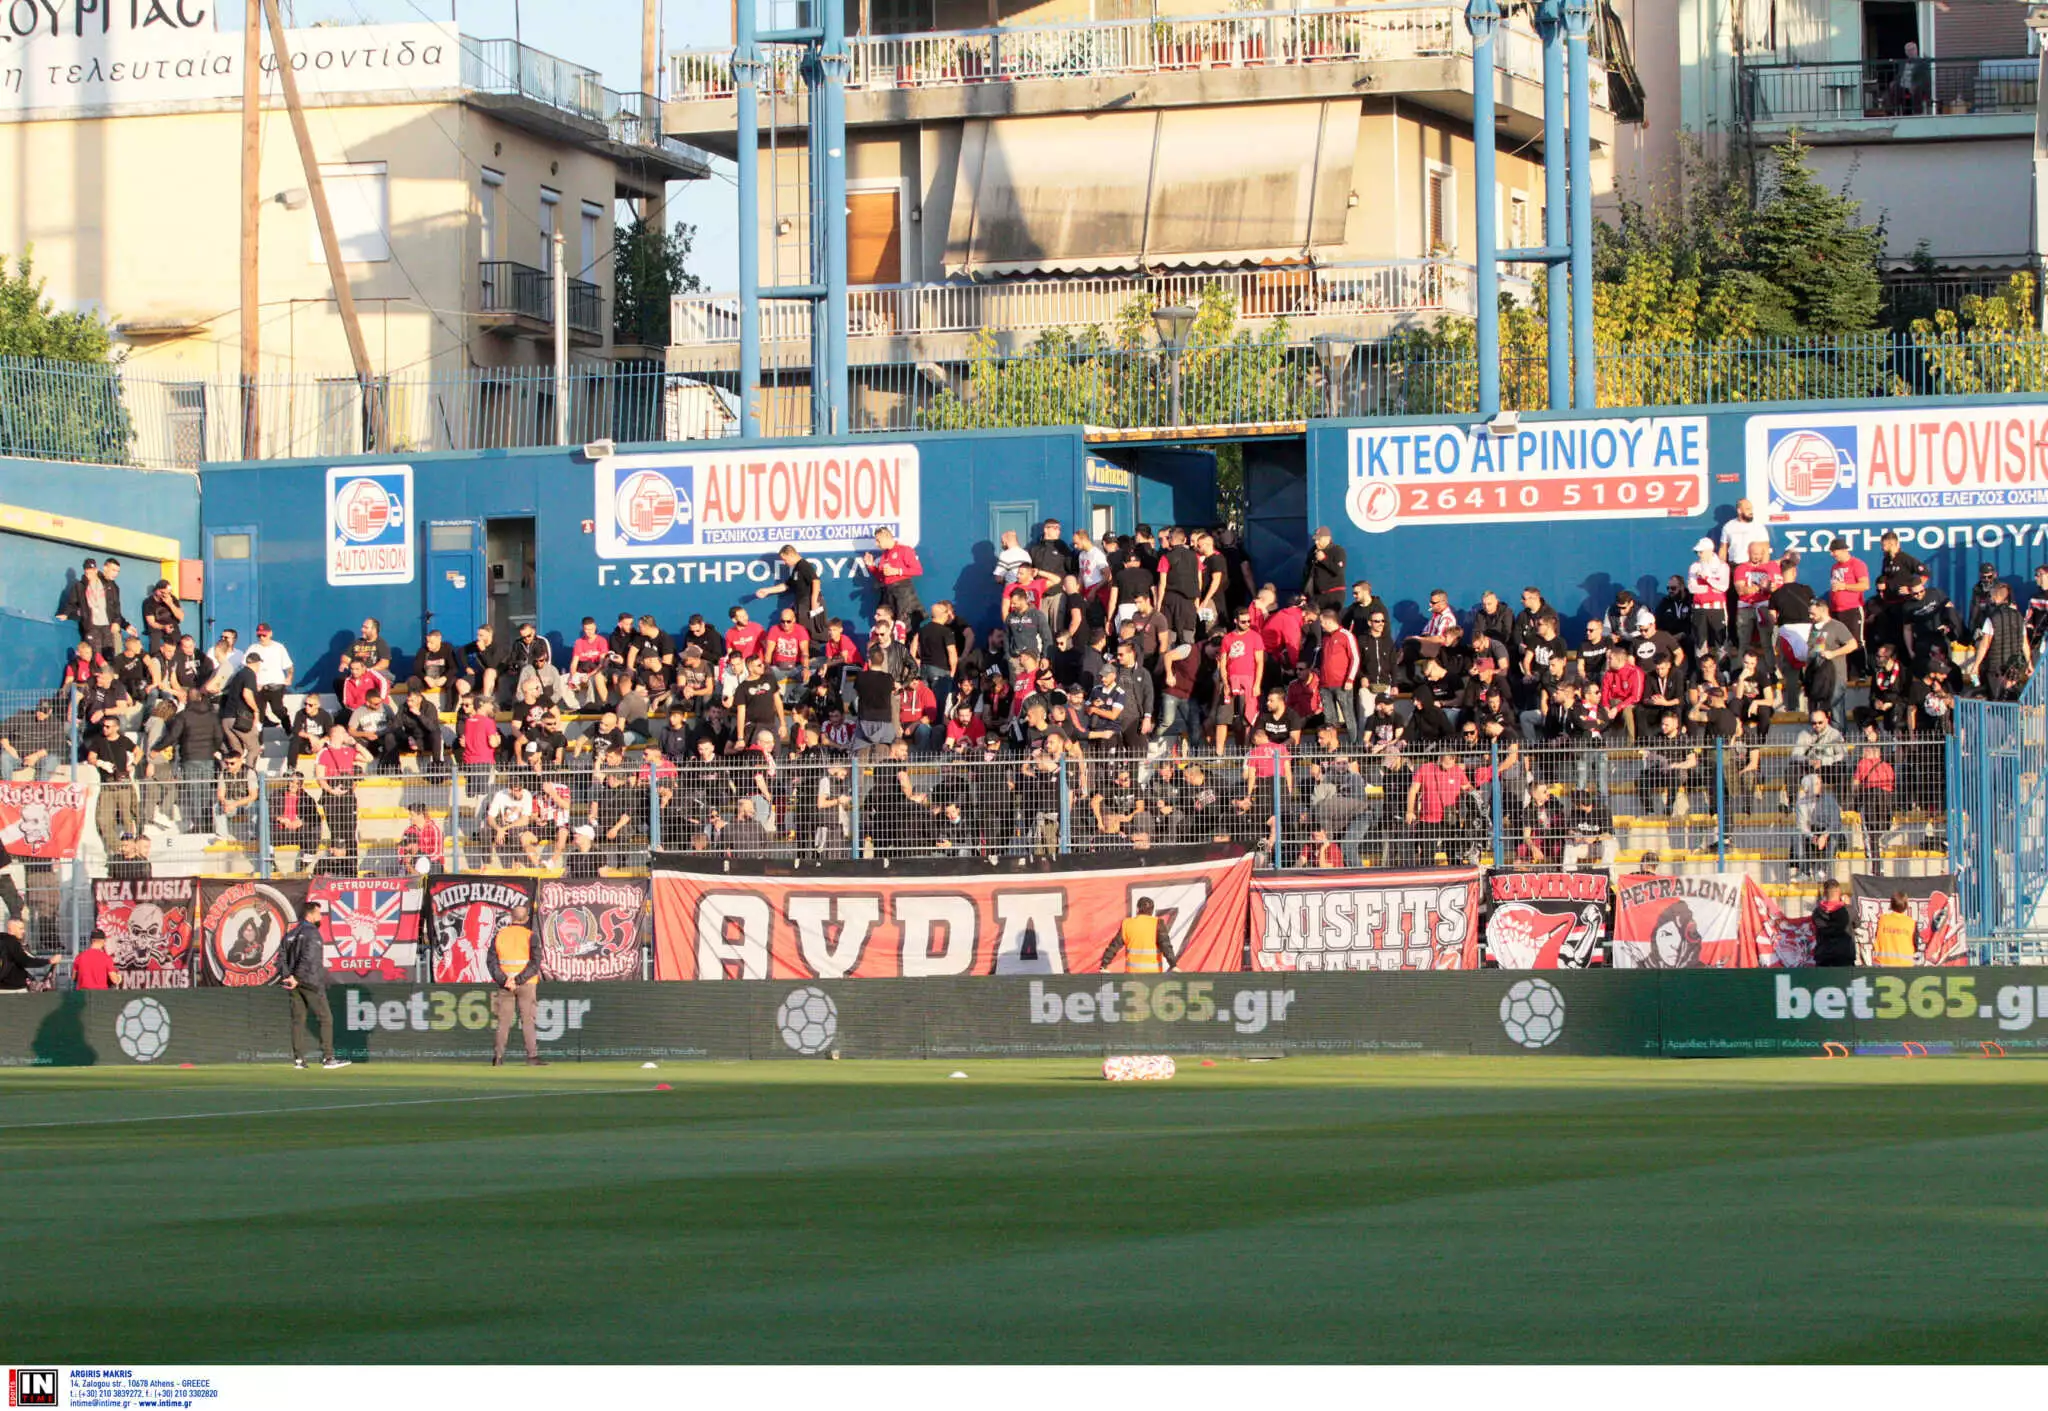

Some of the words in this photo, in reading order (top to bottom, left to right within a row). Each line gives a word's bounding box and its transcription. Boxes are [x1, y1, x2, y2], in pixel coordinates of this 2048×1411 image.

[5, 67, 23, 93] η
[48, 50, 232, 84] τελευταία
[1356, 433, 1460, 477] ΙΚΤΕΟ
[1471, 427, 1643, 473] ΑΓΡΙΝΙΟΥ
[1654, 425, 1700, 466] ΑΕ
[702, 457, 900, 523] AUTOVISION
[1410, 485, 1539, 511] 26410
[1562, 480, 1694, 506] 51097
[1871, 493, 1939, 508] ΤΕΧΝΙΚΟΣ
[1943, 490, 2004, 506] ΕΛΕΓΧΟΣ
[704, 527, 766, 543] ΤΕΧΝΙΚΟΣ
[768, 526, 823, 541] ΕΛΕΓΧΟΣ
[826, 524, 897, 539] ΟΧΗΜΑΤΝ
[335, 548, 407, 571] AUTOVISION
[598, 564, 620, 586] Γ.
[96, 880, 134, 900] NEA
[137, 879, 192, 899] LIOSIA
[330, 880, 401, 891] PETROUPOLI
[541, 882, 642, 913] Messolonghi
[1620, 878, 1738, 908] PETRALONA
[1127, 877, 1213, 973] 7
[1262, 885, 1467, 951] MISFITS
[341, 959, 372, 969] GATE
[374, 959, 382, 969] 7
[1029, 981, 1295, 1034] bet365.gr
